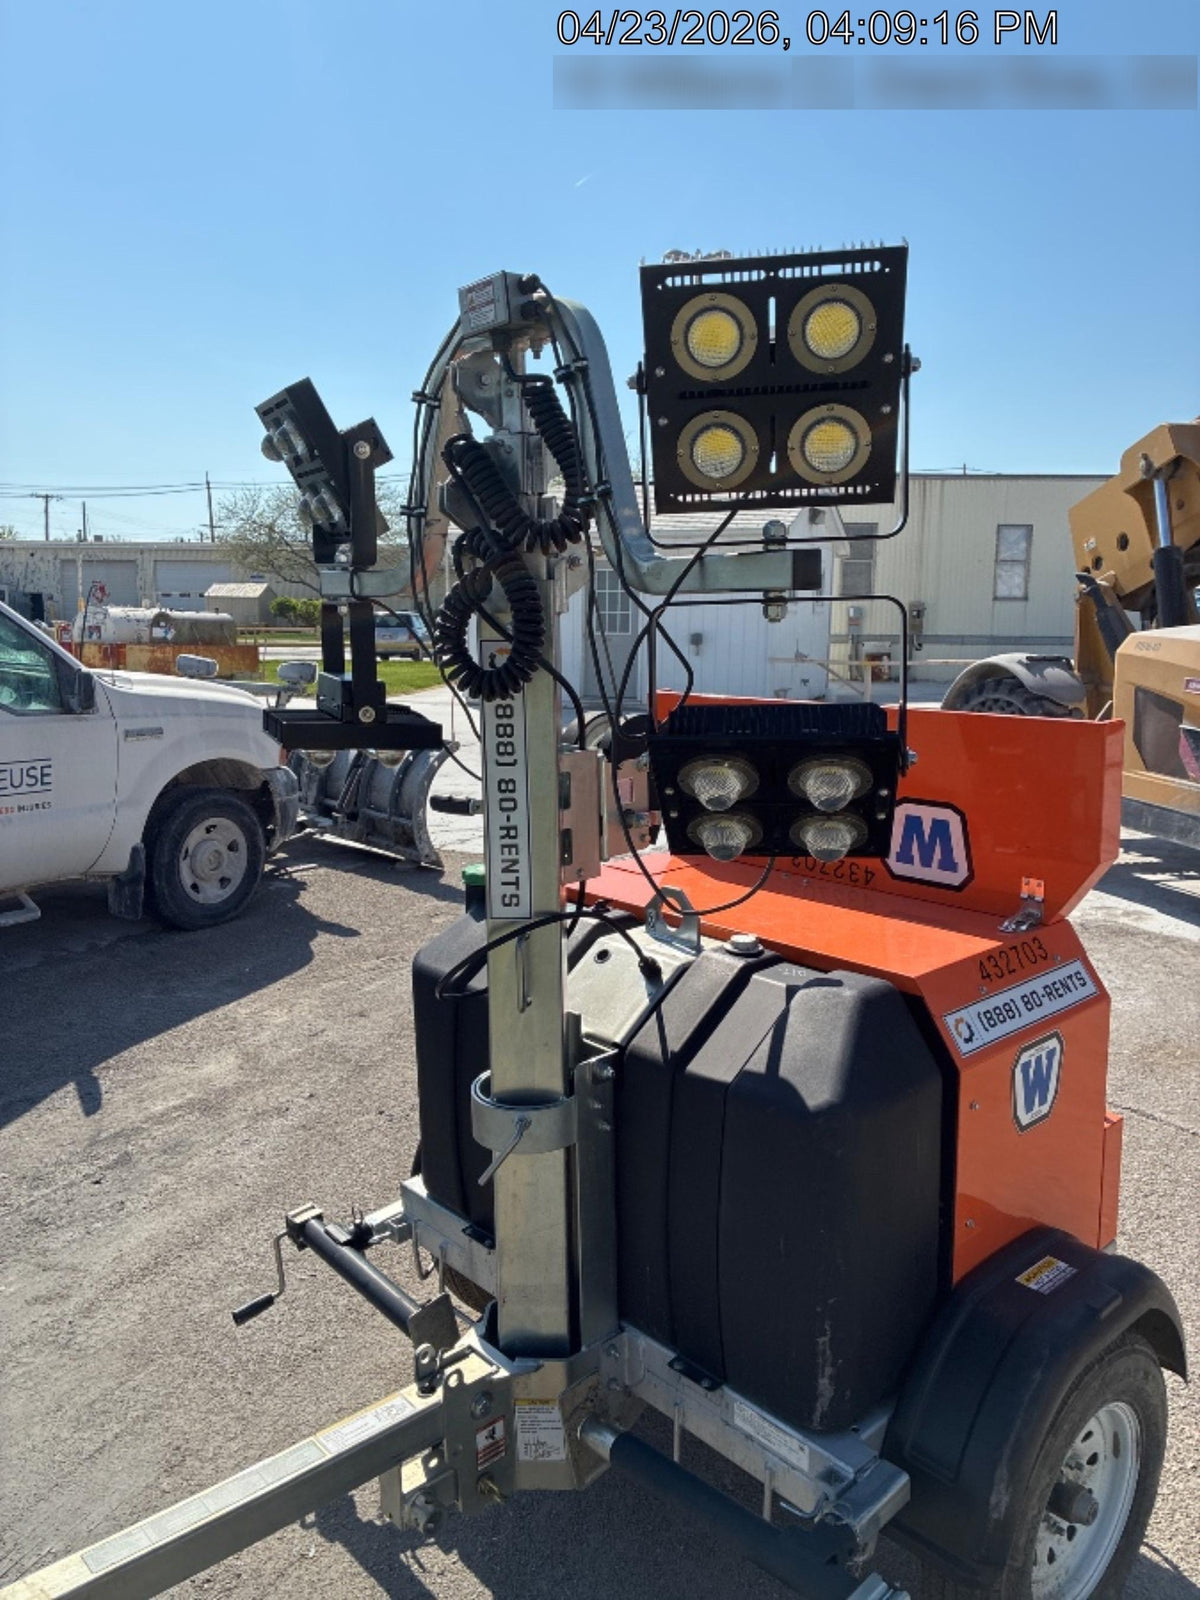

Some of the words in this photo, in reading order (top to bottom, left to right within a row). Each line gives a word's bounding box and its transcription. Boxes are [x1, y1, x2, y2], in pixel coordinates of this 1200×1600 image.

[495, 694, 518, 768] 888)
[978, 936, 1049, 983] 432703
[977, 998, 1022, 1032] (888)
[1020, 1046, 1057, 1115] W
